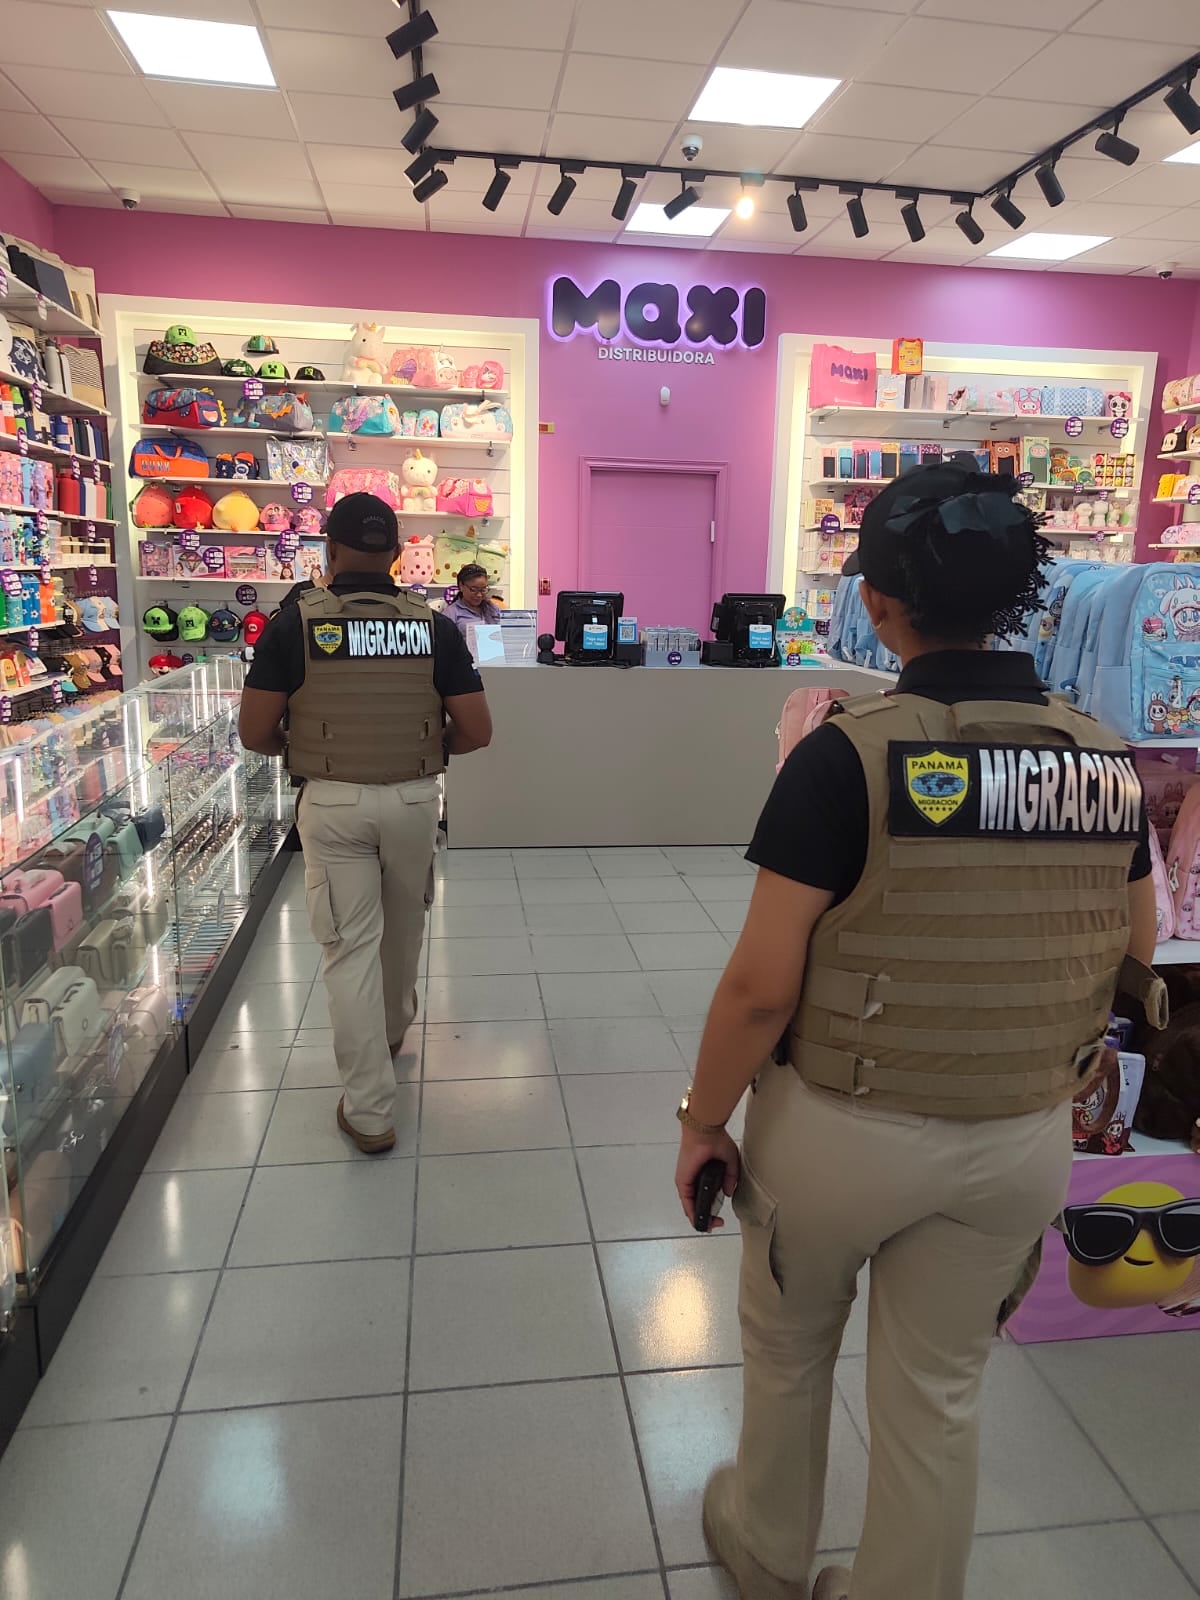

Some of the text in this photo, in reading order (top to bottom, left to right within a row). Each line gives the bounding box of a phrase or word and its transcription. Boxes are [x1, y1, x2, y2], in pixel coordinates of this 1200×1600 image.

[597, 347, 716, 365] DISTRIBUIDORA
[347, 620, 432, 656] MIGRACION
[978, 749, 1143, 832] MIGRACION
